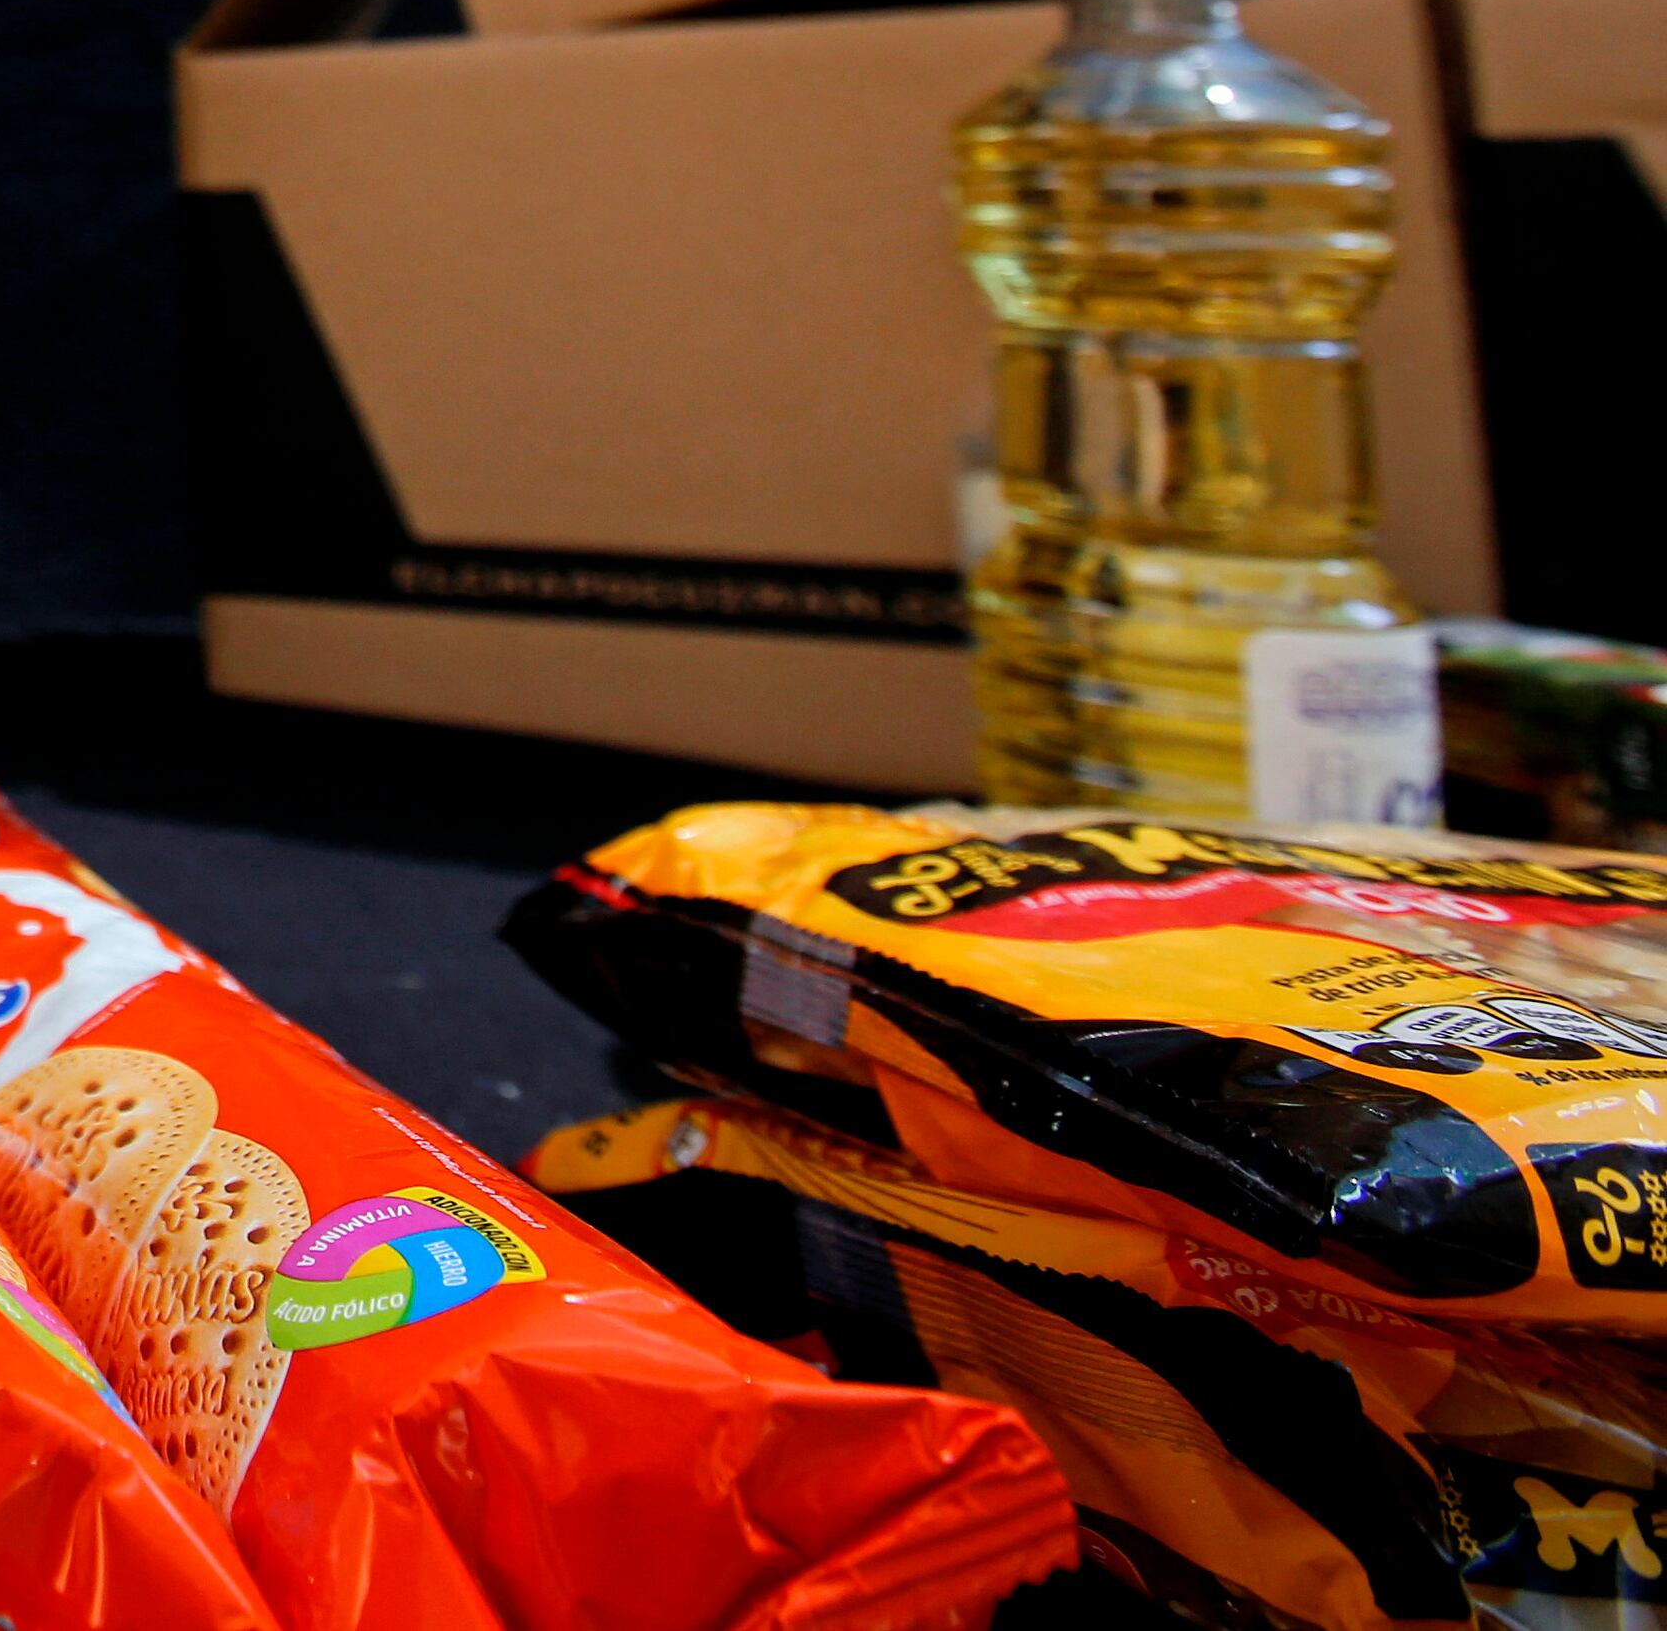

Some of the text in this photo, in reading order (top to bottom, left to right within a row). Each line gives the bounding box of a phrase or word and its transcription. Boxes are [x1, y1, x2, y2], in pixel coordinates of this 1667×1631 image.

[1308, 983, 1342, 1002] de
[1349, 972, 1415, 996] trigo
[297, 1204, 413, 1267] VITAMINA A
[424, 1195, 533, 1274] ADICIONADO CON
[423, 1240, 468, 1287] HIERRO
[274, 1293, 405, 1323] ÁCIDO FÓLICO
